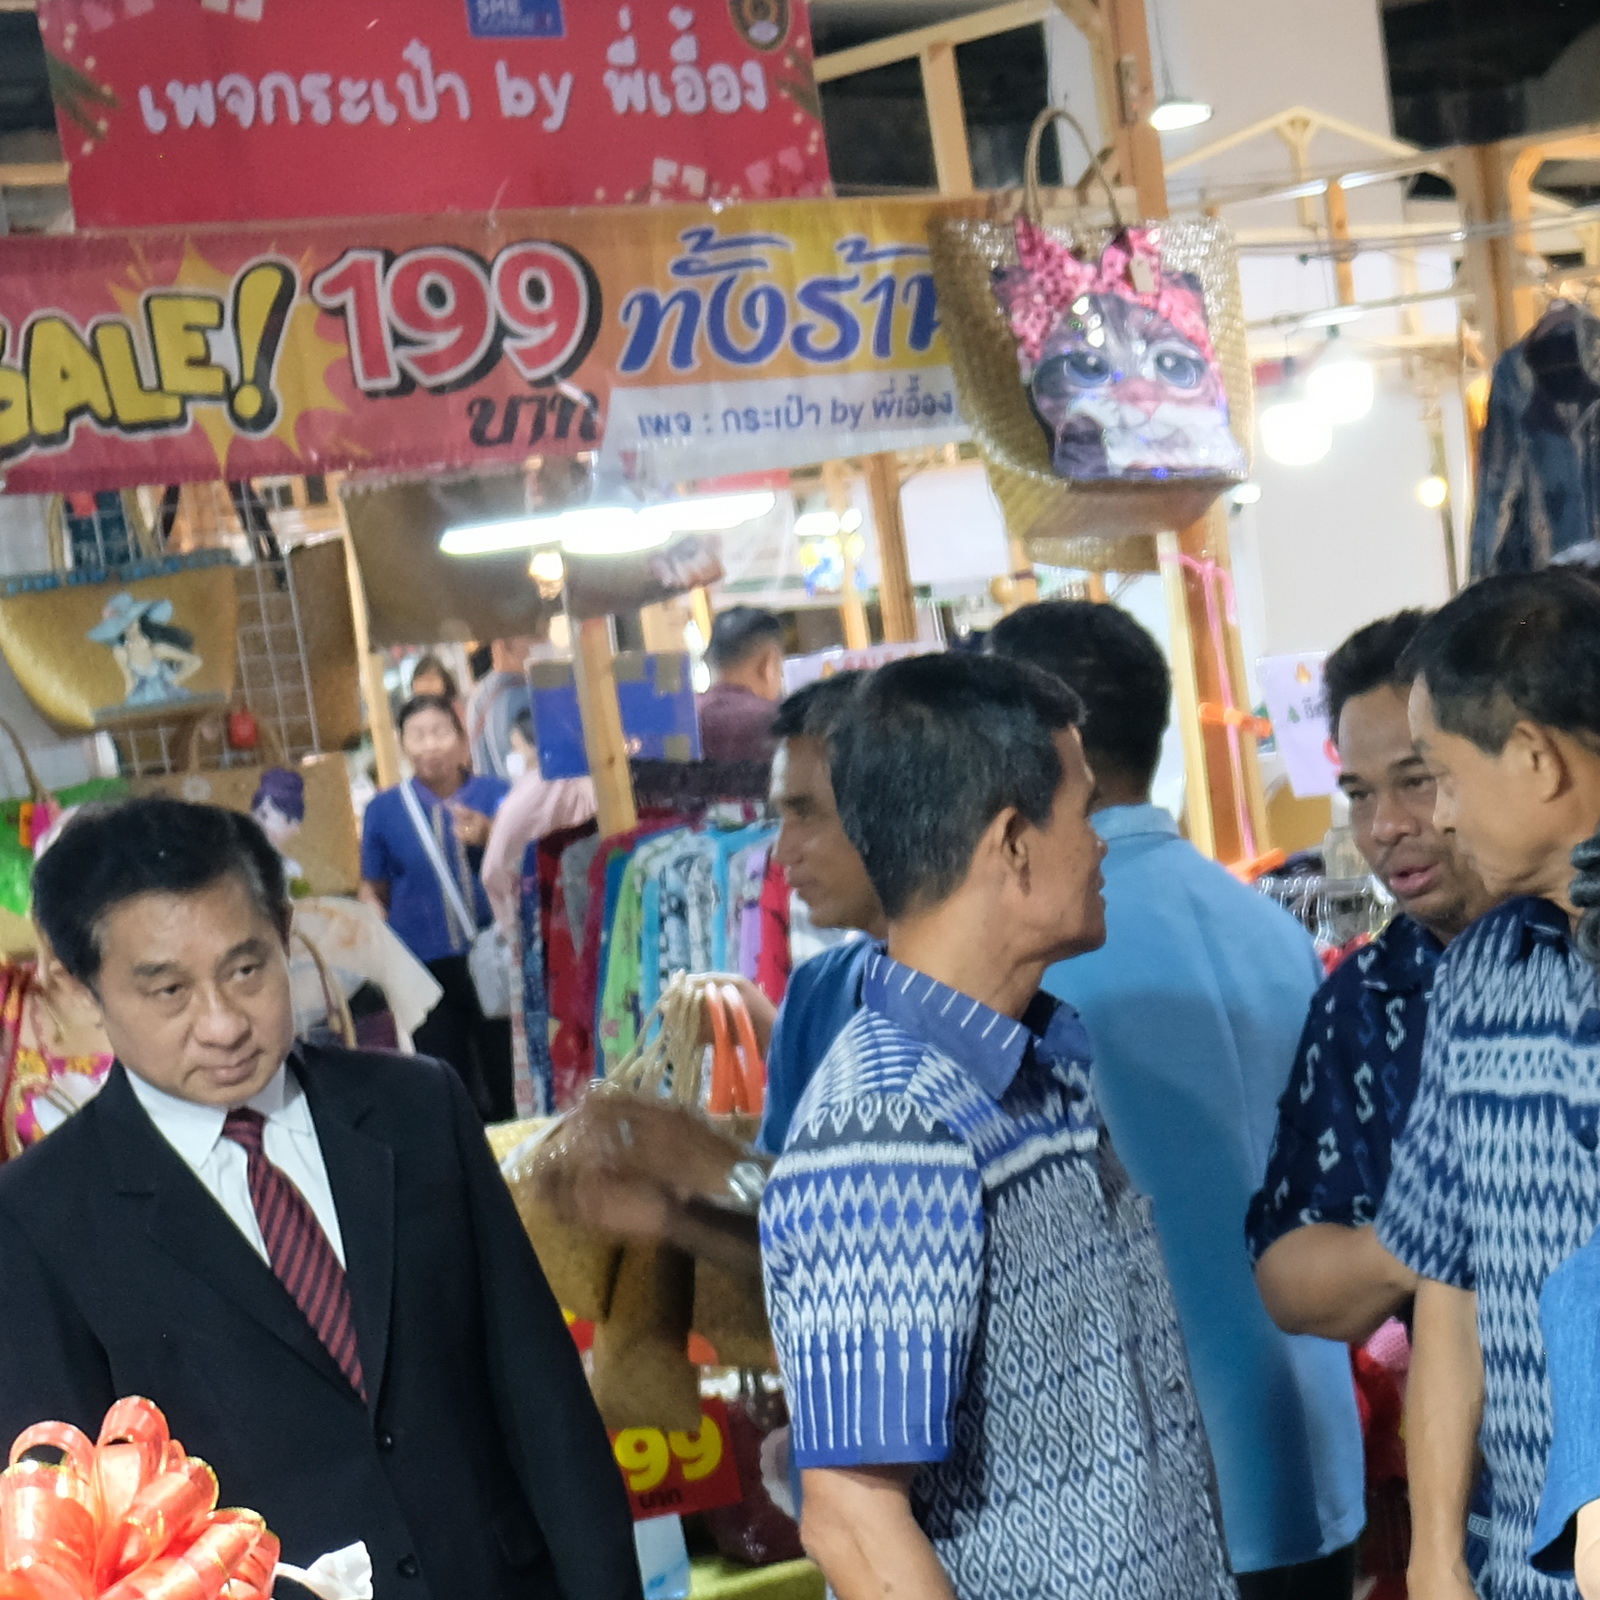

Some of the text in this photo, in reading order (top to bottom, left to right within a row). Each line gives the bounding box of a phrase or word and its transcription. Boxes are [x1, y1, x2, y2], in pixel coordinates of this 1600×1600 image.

[138, 38, 470, 135] เพจกระเป๋า
[494, 59, 574, 133] by
[311, 241, 602, 397] 199
[466, 393, 600, 447] บาท
[637, 410, 693, 438] เพจ
[720, 393, 822, 436] กระเป๋า
[829, 396, 864, 430] by
